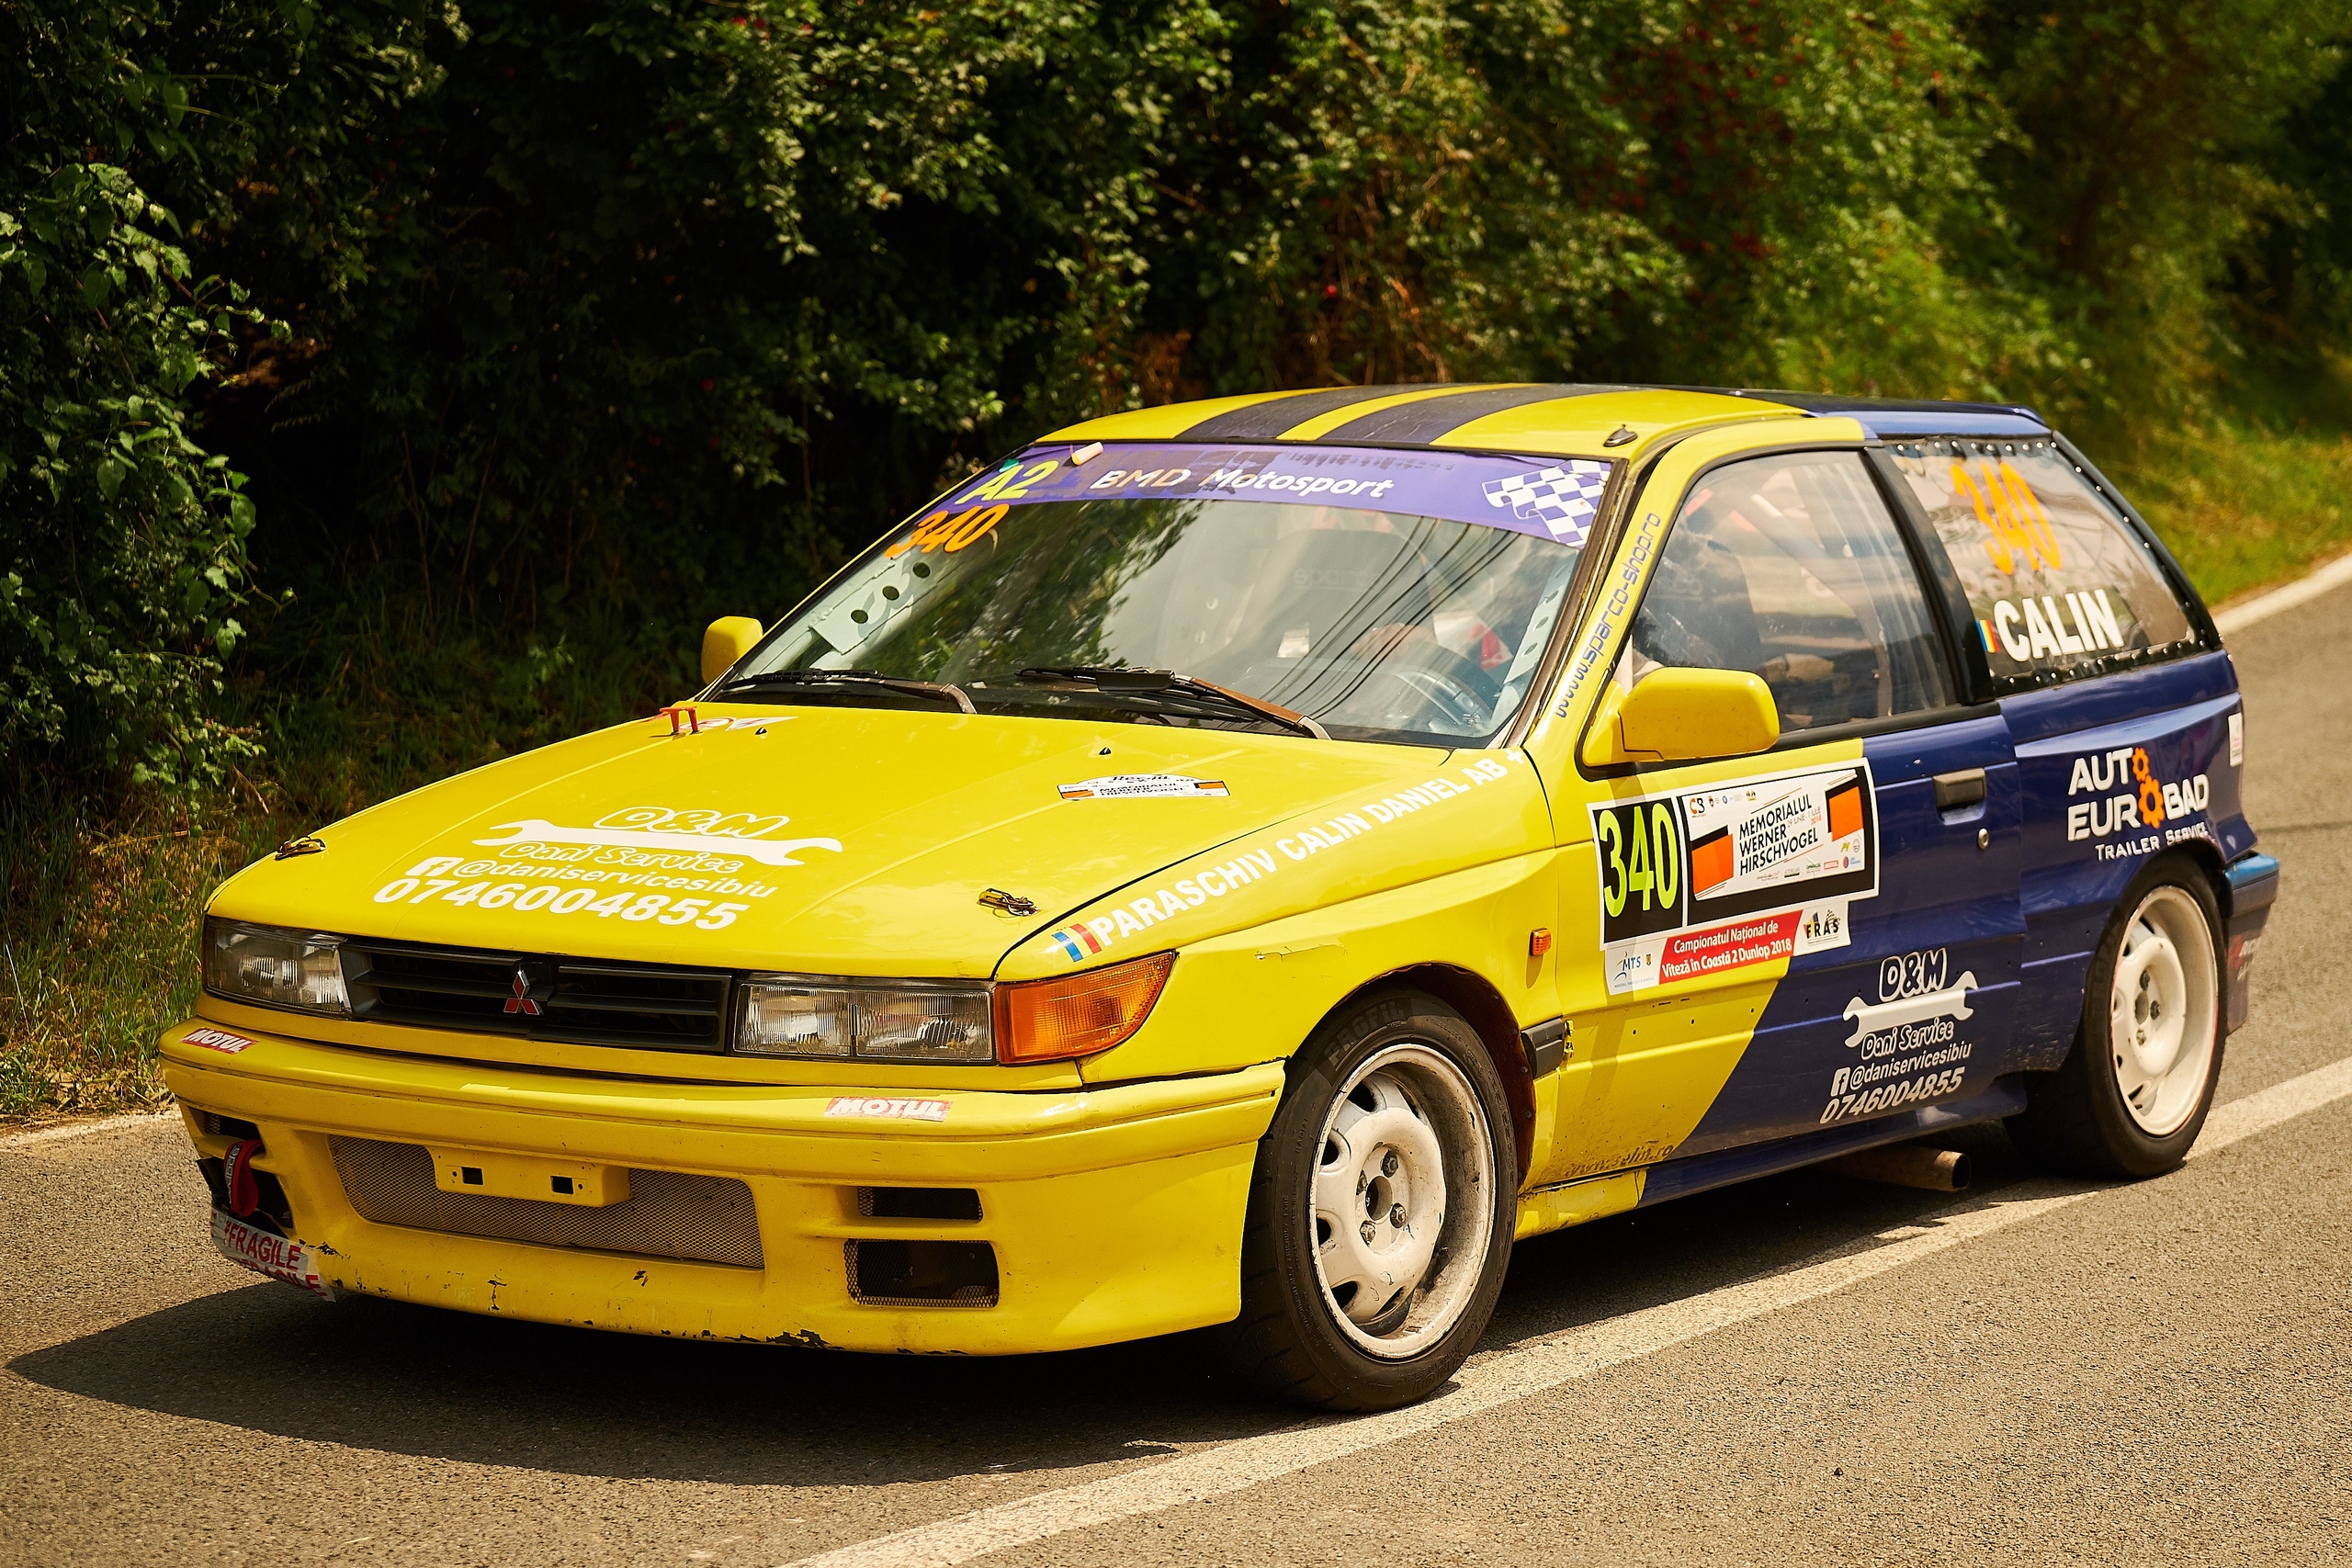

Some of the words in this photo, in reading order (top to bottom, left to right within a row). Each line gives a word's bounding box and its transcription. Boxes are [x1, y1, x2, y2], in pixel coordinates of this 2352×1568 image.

[954, 459, 1060, 505] A2
[1089, 467, 1193, 490] BMD
[1196, 466, 1396, 499] Motosport
[883, 502, 1011, 558] 340
[1949, 461, 2063, 575] 340
[1555, 513, 1662, 718] www.sparco-shop.ro
[1993, 588, 2124, 662] CALIN
[593, 806, 791, 839] D&M
[1739, 793, 1813, 840] MEMORIALUL
[498, 840, 603, 863] Dani
[598, 844, 745, 874] Service
[1091, 847, 1279, 946] PARASCHIV
[1274, 811, 1374, 862] CALIN
[1361, 773, 1473, 824] DANIEL
[1464, 758, 1510, 787] AB
[1599, 802, 1679, 918] 340
[1739, 823, 1787, 857] WERNER
[1739, 827, 1818, 876] HIRSCHVOGEL
[2095, 835, 2161, 862] TRAILER
[453, 856, 779, 899] @daniservicesibiu
[372, 877, 752, 931] 0746004855
[1674, 928, 1730, 953] Campionatul
[1767, 921, 1779, 933] de
[1806, 918, 1839, 939] FRAS
[1622, 956, 1641, 971] MTS
[1661, 959, 1690, 978] Viteză
[1690, 958, 1701, 972] în
[1731, 949, 1737, 960] 2
[1738, 943, 1770, 961] Dunlop
[1770, 938, 1792, 953] 2018
[1878, 947, 1947, 1001] D&M
[181, 1029, 253, 1054] MOTUL
[1861, 1026, 1896, 1060] Dani
[1898, 1016, 1954, 1051] Service
[1849, 1041, 1973, 1089] @daniservicesibiu
[829, 1099, 945, 1118] MOTUL
[1819, 1066, 1965, 1124] 0746004855
[229, 1223, 302, 1271] FRAGILE
